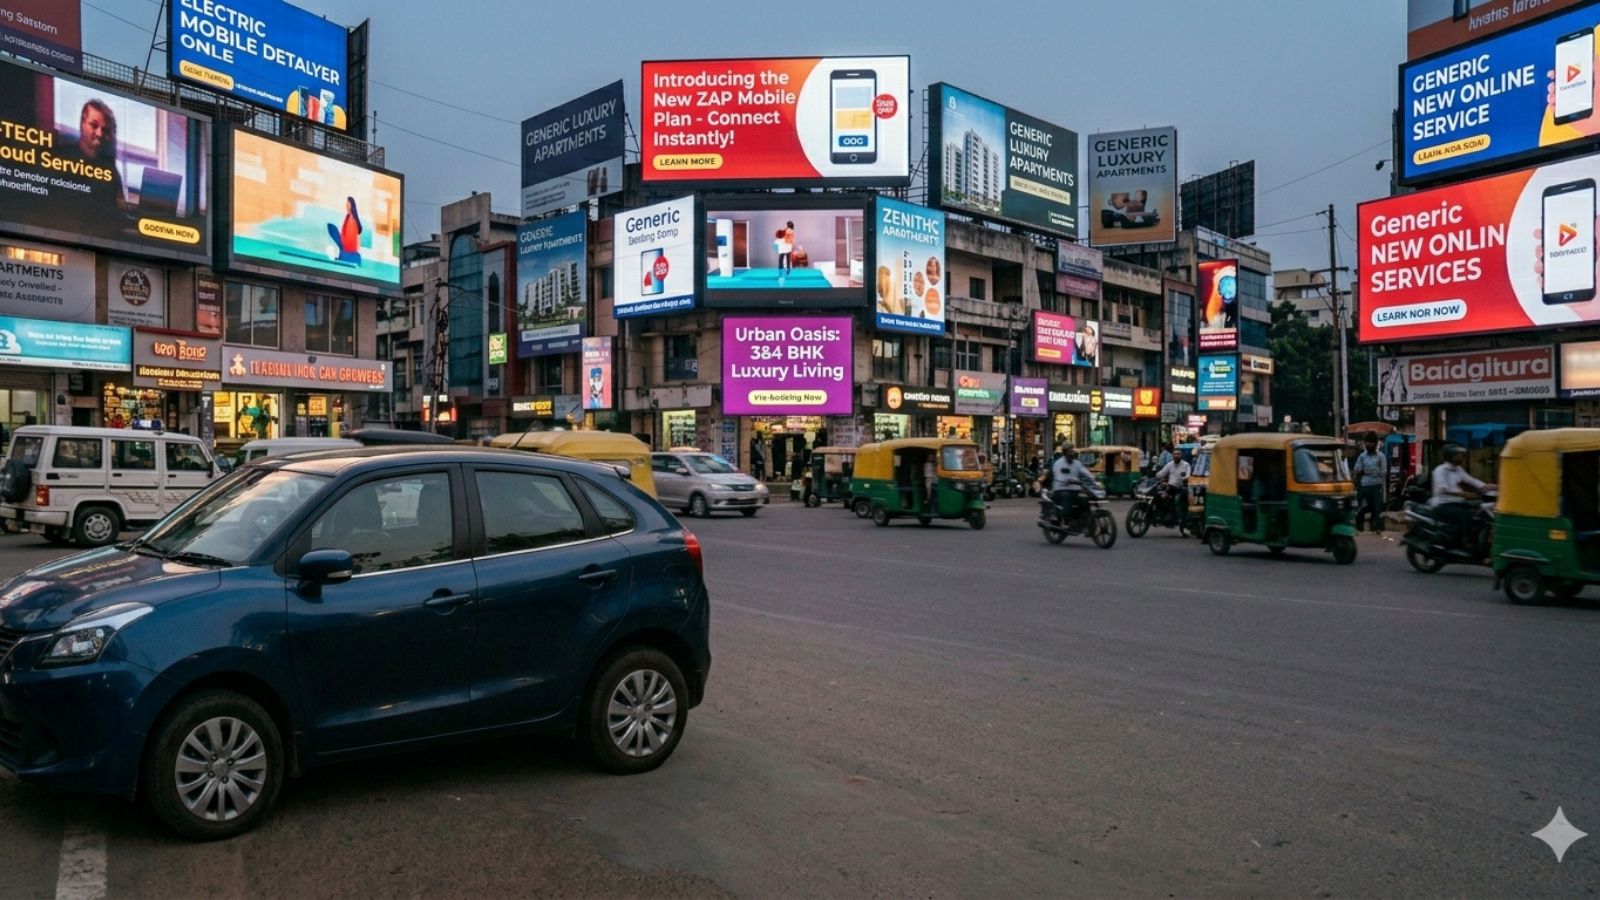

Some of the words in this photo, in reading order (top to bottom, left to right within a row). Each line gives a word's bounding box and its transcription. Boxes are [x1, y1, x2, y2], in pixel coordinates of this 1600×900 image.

[180, 0, 266, 37] ELECTRIC
[180, 11, 258, 55] MOBILE
[263, 43, 340, 86] DETALYER
[180, 34, 234, 64] ONLE
[653, 70, 755, 88] Introducing
[760, 70, 789, 84] the
[1413, 54, 1490, 93] GENERIC
[653, 92, 692, 107] New
[696, 92, 733, 106] ZAP
[738, 89, 796, 105] Mobile
[1413, 89, 1456, 117] NEW
[1460, 64, 1535, 103] ONLINE
[526, 118, 570, 146] GENERIC
[572, 99, 616, 130] LUXURY
[653, 112, 692, 127] Plan
[707, 110, 781, 125] Connect
[1413, 104, 1490, 141] SERVICE
[534, 124, 606, 164] APARTMENTS
[653, 130, 735, 149] Instantly!
[1009, 121, 1053, 147] GENERIC
[1094, 135, 1169, 153] GENERIC
[1009, 138, 1049, 162] LUXURY
[1098, 150, 1165, 167] LUXURY
[40, 151, 113, 182] Services
[1096, 165, 1167, 179] APARTMENTS
[626, 207, 680, 233] Generic
[883, 207, 940, 236] ZENITHC
[1371, 200, 1463, 237] Generic
[1371, 237, 1424, 266] NEW
[1429, 223, 1505, 256] ONLIN
[1371, 257, 1482, 293] SERVICES
[1410, 308, 1431, 318] NOR
[1433, 305, 1460, 316] NOW
[735, 327, 786, 342] Urban
[790, 326, 841, 342] Oasis:
[787, 345, 825, 360] BHK
[731, 363, 789, 382] Luxury
[793, 362, 845, 382] Living
[803, 394, 822, 402] Now
